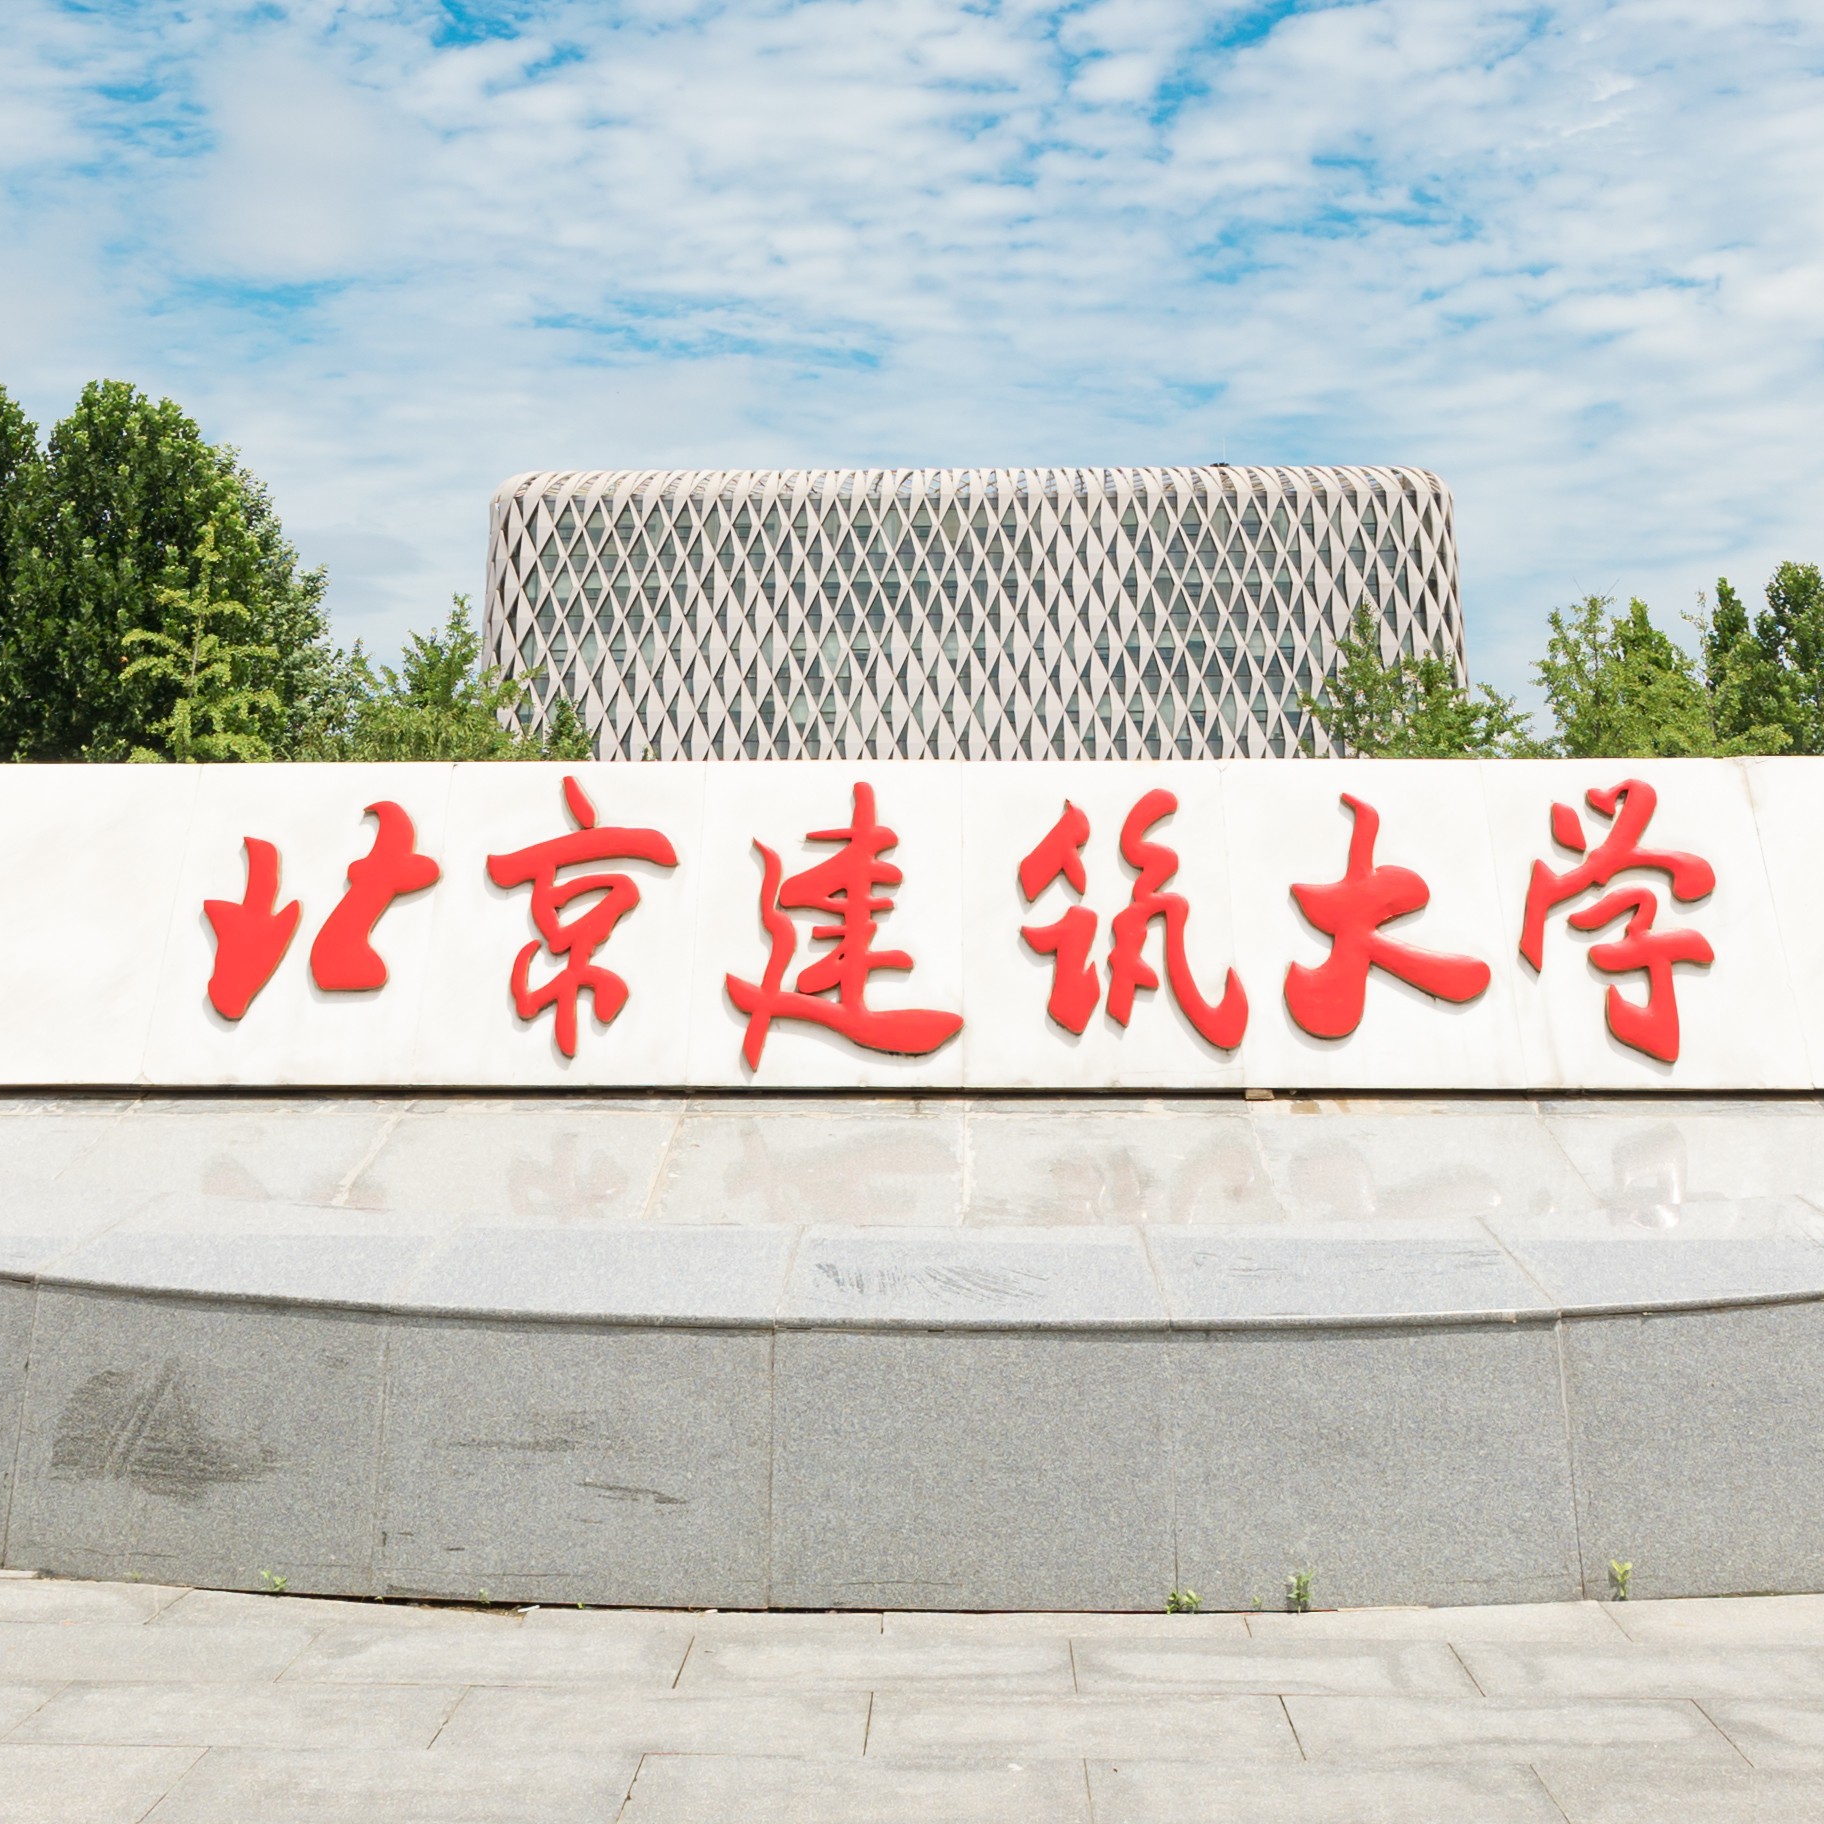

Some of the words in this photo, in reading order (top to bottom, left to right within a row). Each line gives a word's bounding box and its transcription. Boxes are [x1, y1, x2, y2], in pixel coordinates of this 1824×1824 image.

[202, 775, 1717, 1071] 北京建筑大学
